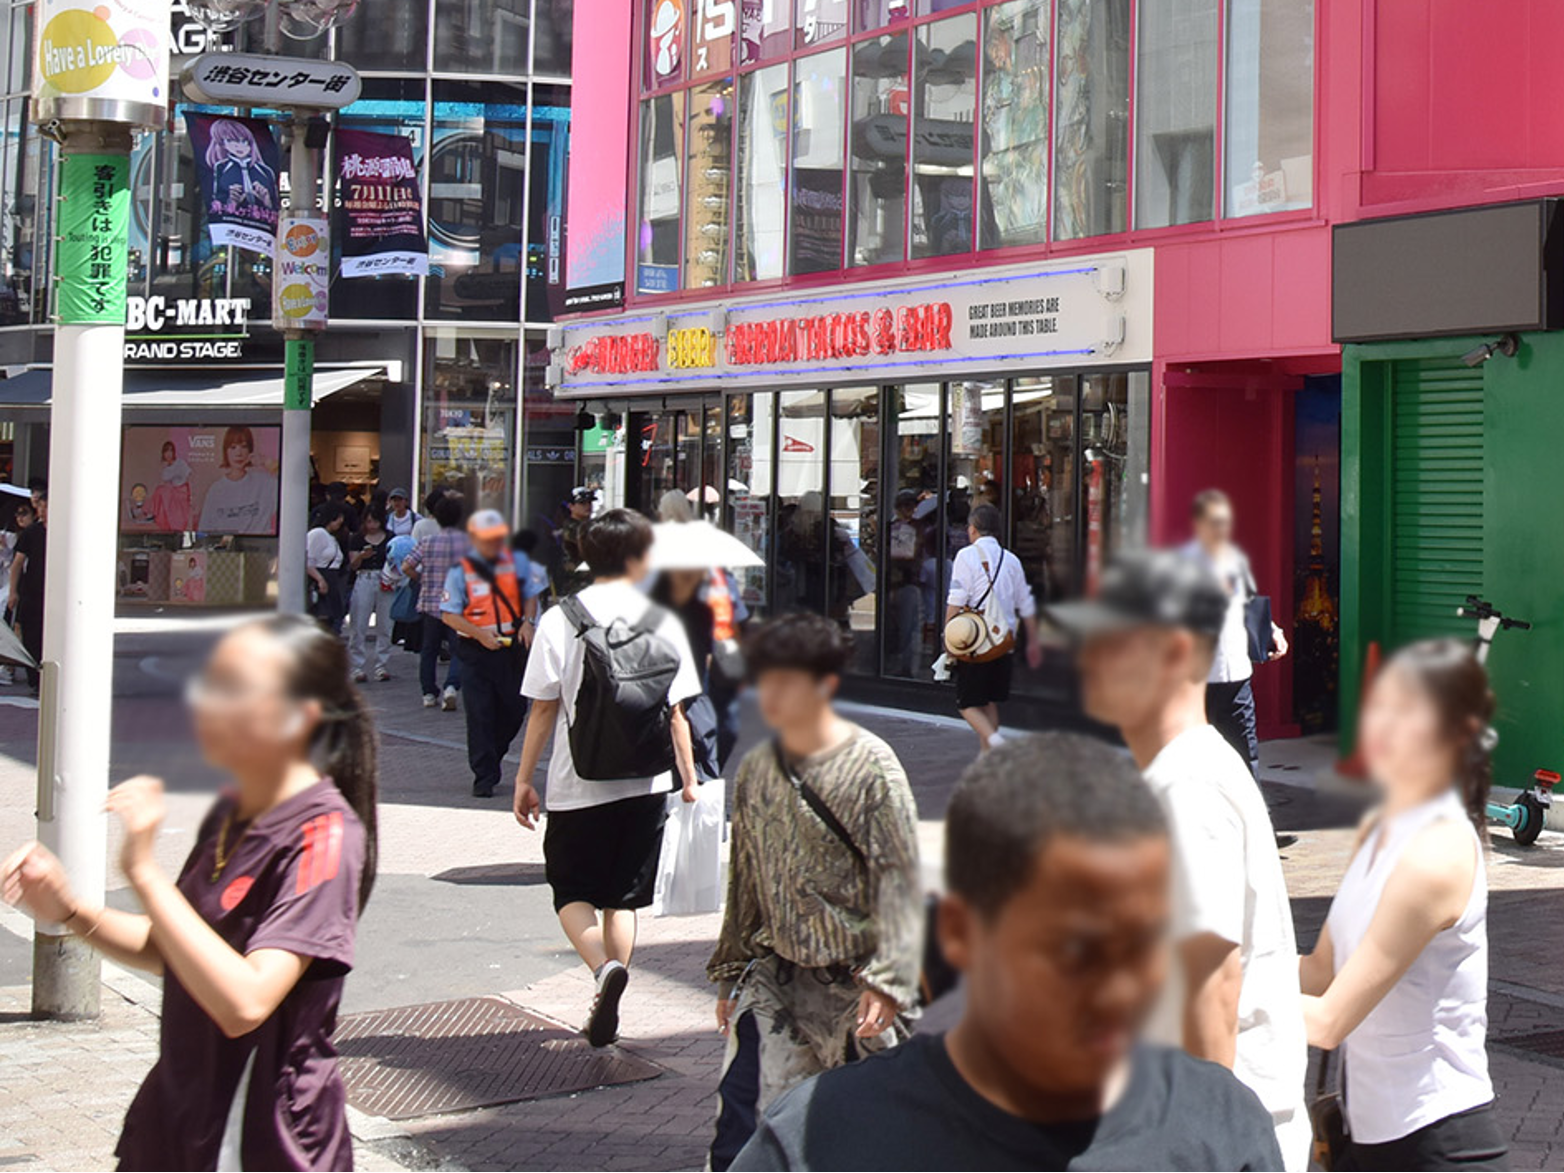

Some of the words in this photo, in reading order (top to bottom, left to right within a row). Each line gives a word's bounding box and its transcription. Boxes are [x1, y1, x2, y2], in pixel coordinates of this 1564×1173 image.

[44, 38, 76, 77] Have
[77, 46, 86, 70] a
[86, 38, 133, 67] Lovely
[203, 65, 352, 94] 渋谷センター街
[90, 164, 116, 314] 客引きは犯罪です
[127, 295, 246, 331] BC-MART
[124, 343, 177, 359] RAND
[180, 342, 240, 358] STAGE
